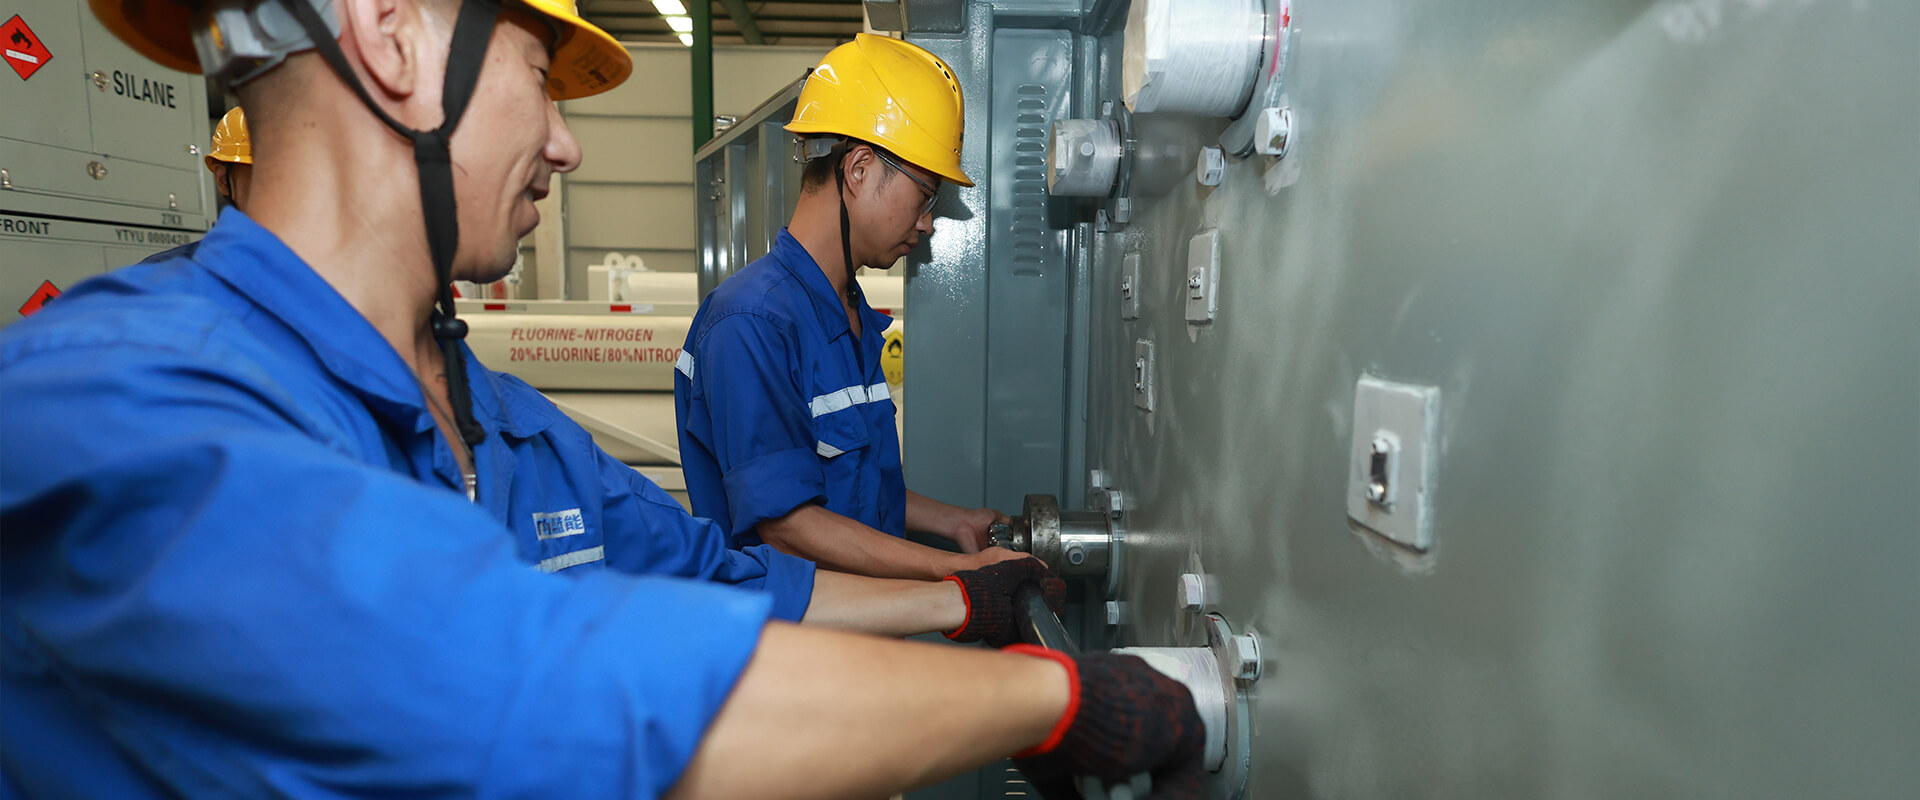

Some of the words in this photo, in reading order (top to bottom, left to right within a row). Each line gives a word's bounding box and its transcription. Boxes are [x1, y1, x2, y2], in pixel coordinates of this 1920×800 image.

[113, 70, 176, 109] SILANE
[0, 218, 50, 235] RONT
[115, 229, 145, 243] YTYU
[511, 328, 653, 342] FLUORINE-NITROGEN
